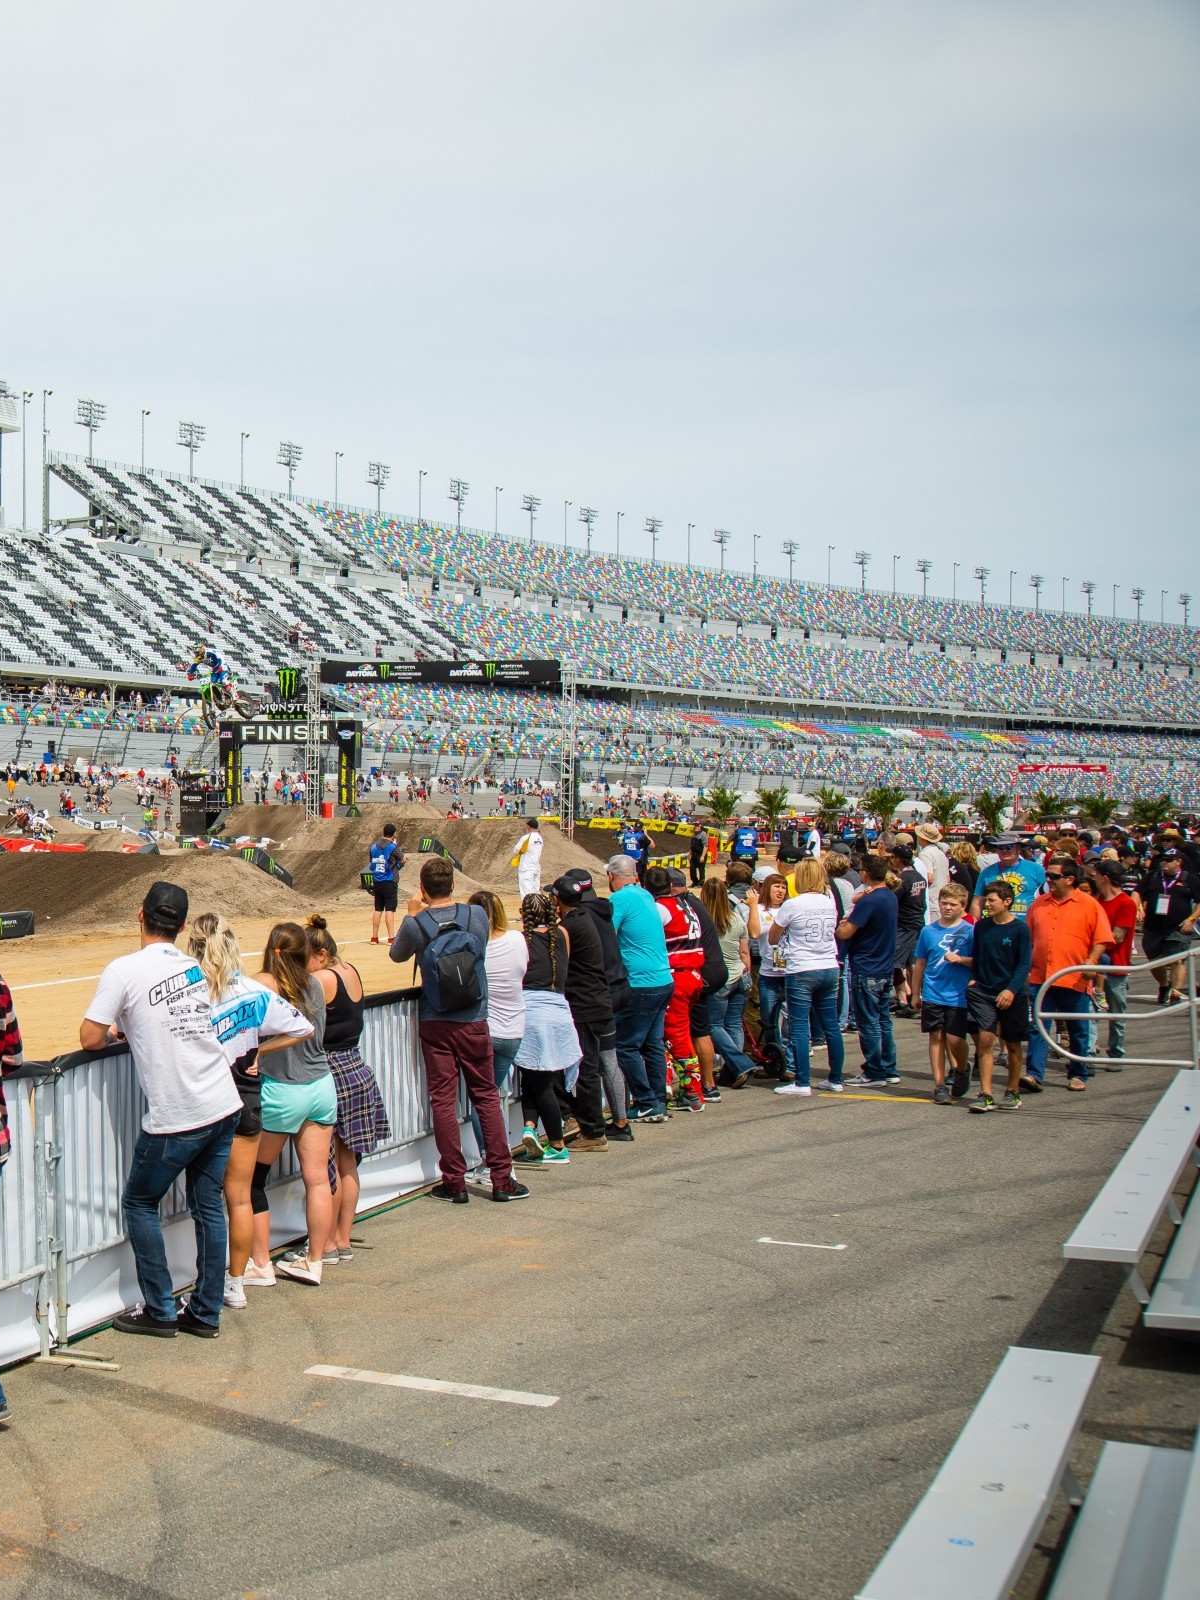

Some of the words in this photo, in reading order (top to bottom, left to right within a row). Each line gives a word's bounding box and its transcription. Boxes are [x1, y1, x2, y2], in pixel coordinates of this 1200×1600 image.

[449, 669, 484, 677] DAYTONA
[241, 725, 328, 741] FINISH
[805, 917, 835, 943] 36
[166, 991, 184, 1006] RSR
